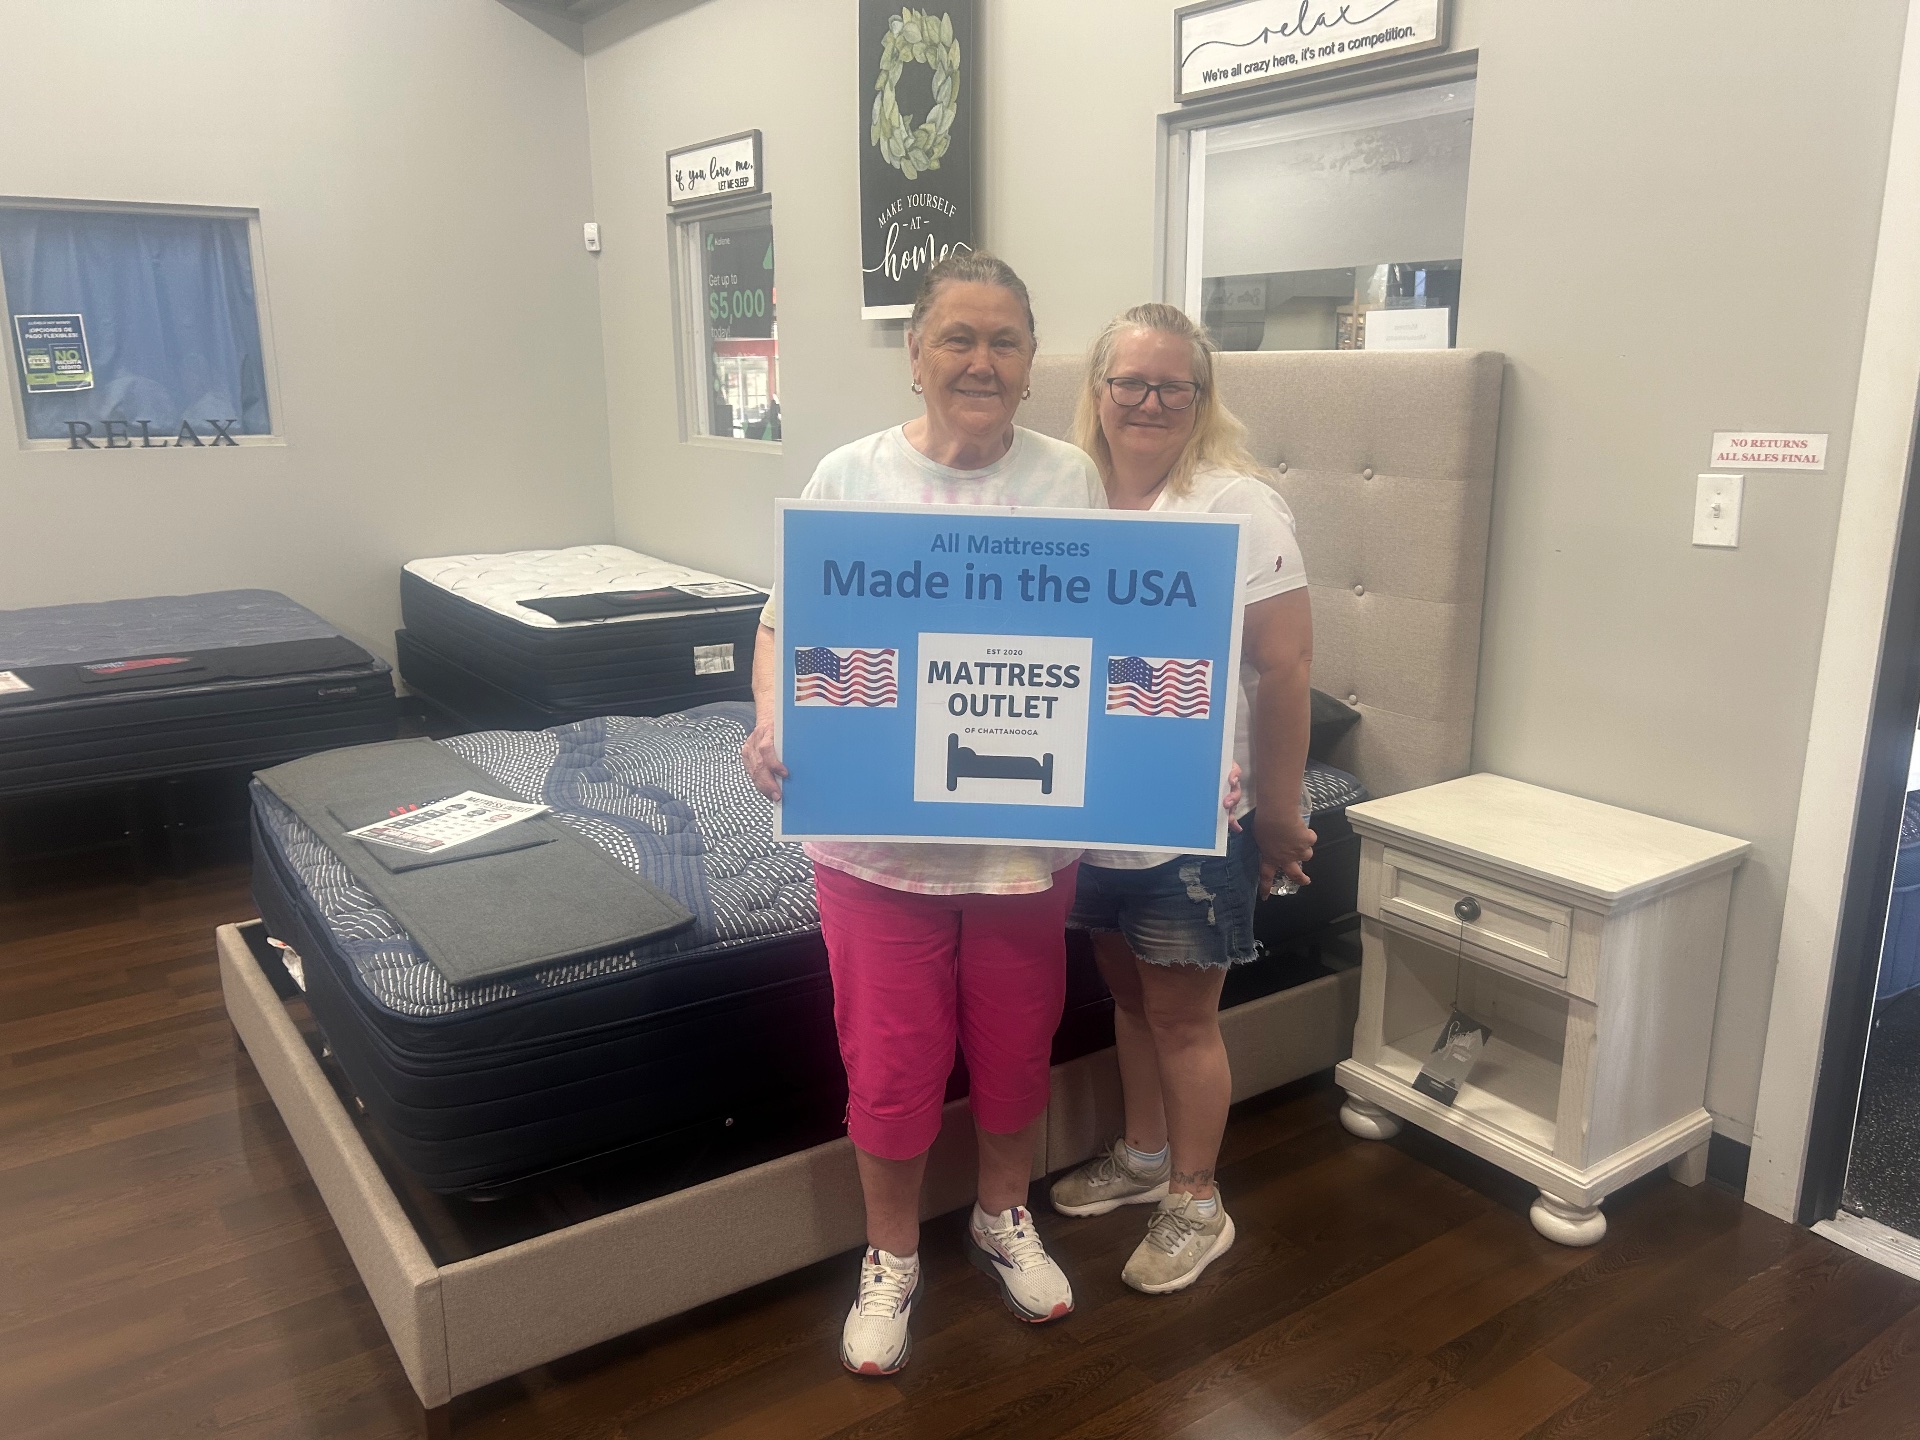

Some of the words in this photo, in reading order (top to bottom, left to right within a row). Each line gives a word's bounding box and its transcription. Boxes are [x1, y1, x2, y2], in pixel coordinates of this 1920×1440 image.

[1202, 69, 1229, 84] We're
[1230, 64, 1242, 78] all
[1244, 58, 1270, 75] crazy
[1272, 51, 1298, 69] here,
[1300, 47, 1316, 62] it's
[1318, 43, 1335, 58] not
[1337, 41, 1345, 53] a
[1347, 25, 1416, 51] competition.
[675, 169, 685, 191] if
[688, 169, 707, 191] you
[709, 157, 731, 180] love
[718, 180, 727, 191] LET
[727, 179, 735, 189] ME
[735, 176, 749, 188] SLEEP
[877, 198, 903, 229] MAKE
[907, 193, 957, 218] YOURSELF
[869, 222, 962, 282] home
[708, 274, 720, 287] Get
[721, 275, 729, 289] up
[730, 273, 738, 285] to
[710, 288, 765, 325] $5,000
[711, 324, 731, 340] today!
[54, 349, 80, 361] NO
[64, 419, 240, 450] RELAX
[1730, 438, 1748, 448] NO
[1750, 439, 1808, 449] RETURNS
[1717, 452, 1740, 462] ALL
[1741, 453, 1779, 463] SALES
[1781, 454, 1820, 464] FINAL
[930, 533, 959, 553] All
[967, 534, 1091, 557] Mattresses
[822, 558, 950, 600] Made
[965, 562, 1004, 602] in
[1017, 564, 1092, 605] the
[1107, 568, 1198, 608] USA
[986, 648, 1002, 656] EST
[1003, 648, 1023, 657] 2020
[927, 660, 1081, 689] MATTRESS
[947, 692, 1060, 720] OUTLET
[964, 727, 976, 735] OF
[977, 727, 1039, 737] CHATTANOOGA
